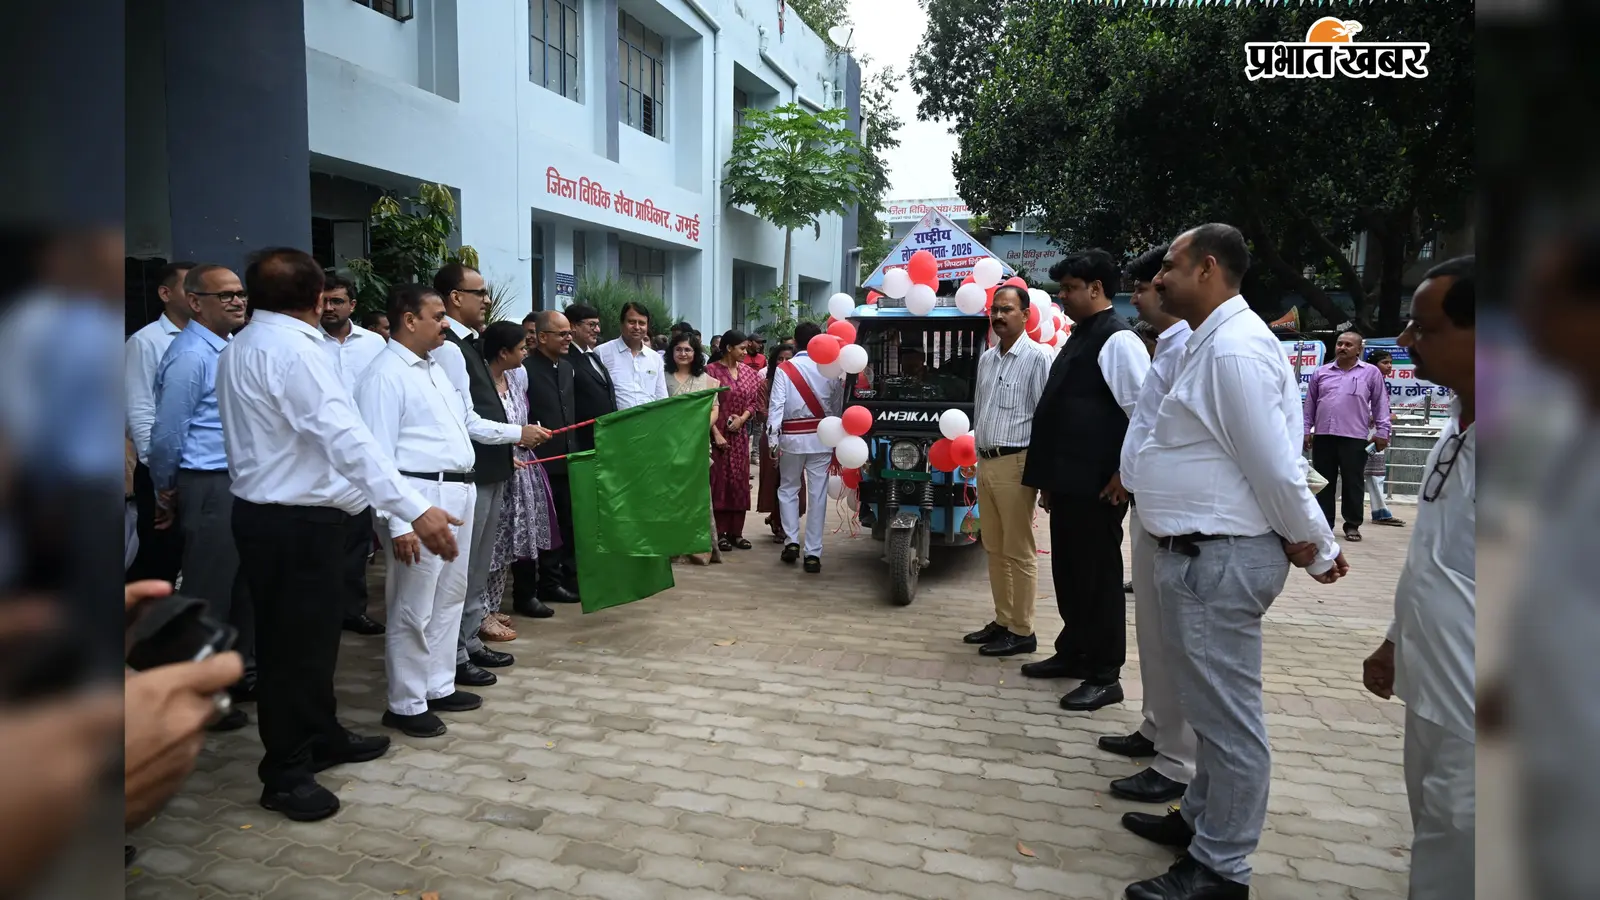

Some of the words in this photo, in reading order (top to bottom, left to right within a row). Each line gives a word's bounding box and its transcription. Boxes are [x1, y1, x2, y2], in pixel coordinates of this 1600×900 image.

[546, 166, 577, 200] जिला
[579, 176, 611, 210] विधिक
[614, 190, 634, 217] सेवा
[675, 214, 700, 242] जमुई
[914, 228, 952, 245] राष्ट्रीय
[951, 242, 972, 257] 2026
